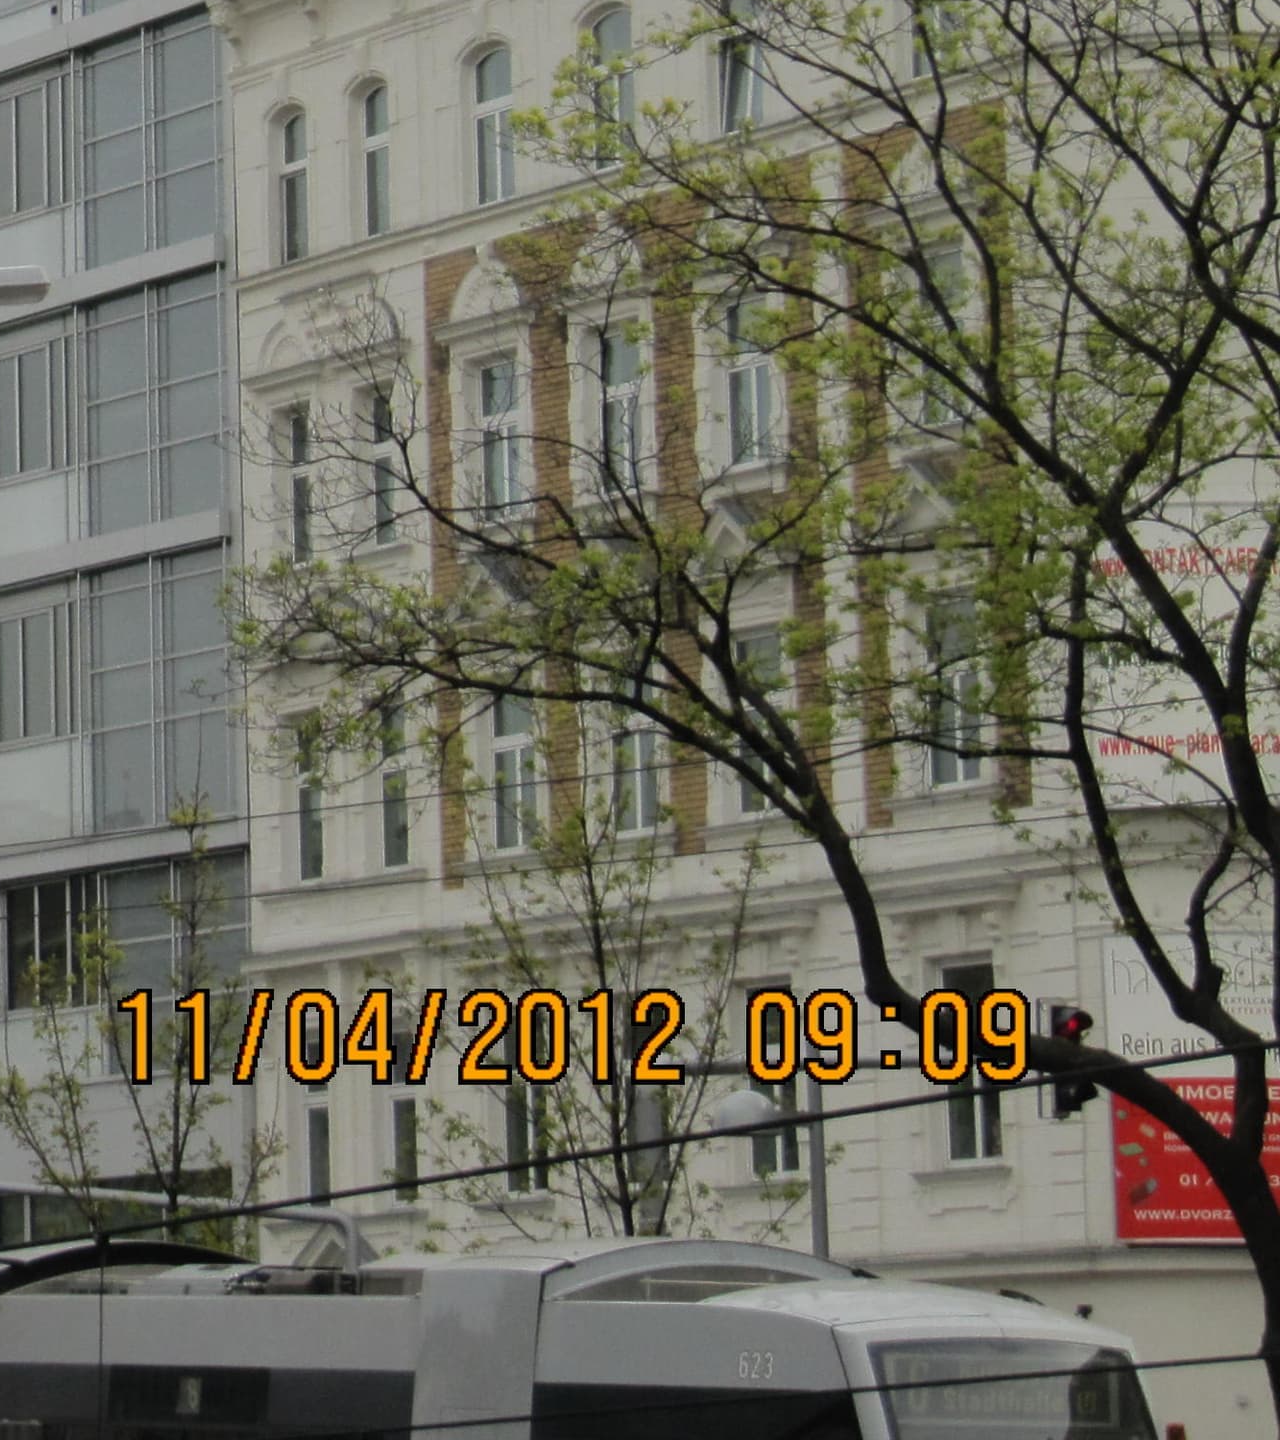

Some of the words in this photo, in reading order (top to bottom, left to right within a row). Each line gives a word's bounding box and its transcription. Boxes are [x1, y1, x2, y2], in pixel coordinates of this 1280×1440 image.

[1122, 1033, 1164, 1056] Rein
[1171, 1037, 1206, 1054] aus
[1133, 1210, 1235, 1221] WWW.DVORZ
[739, 1352, 774, 1379] 623
